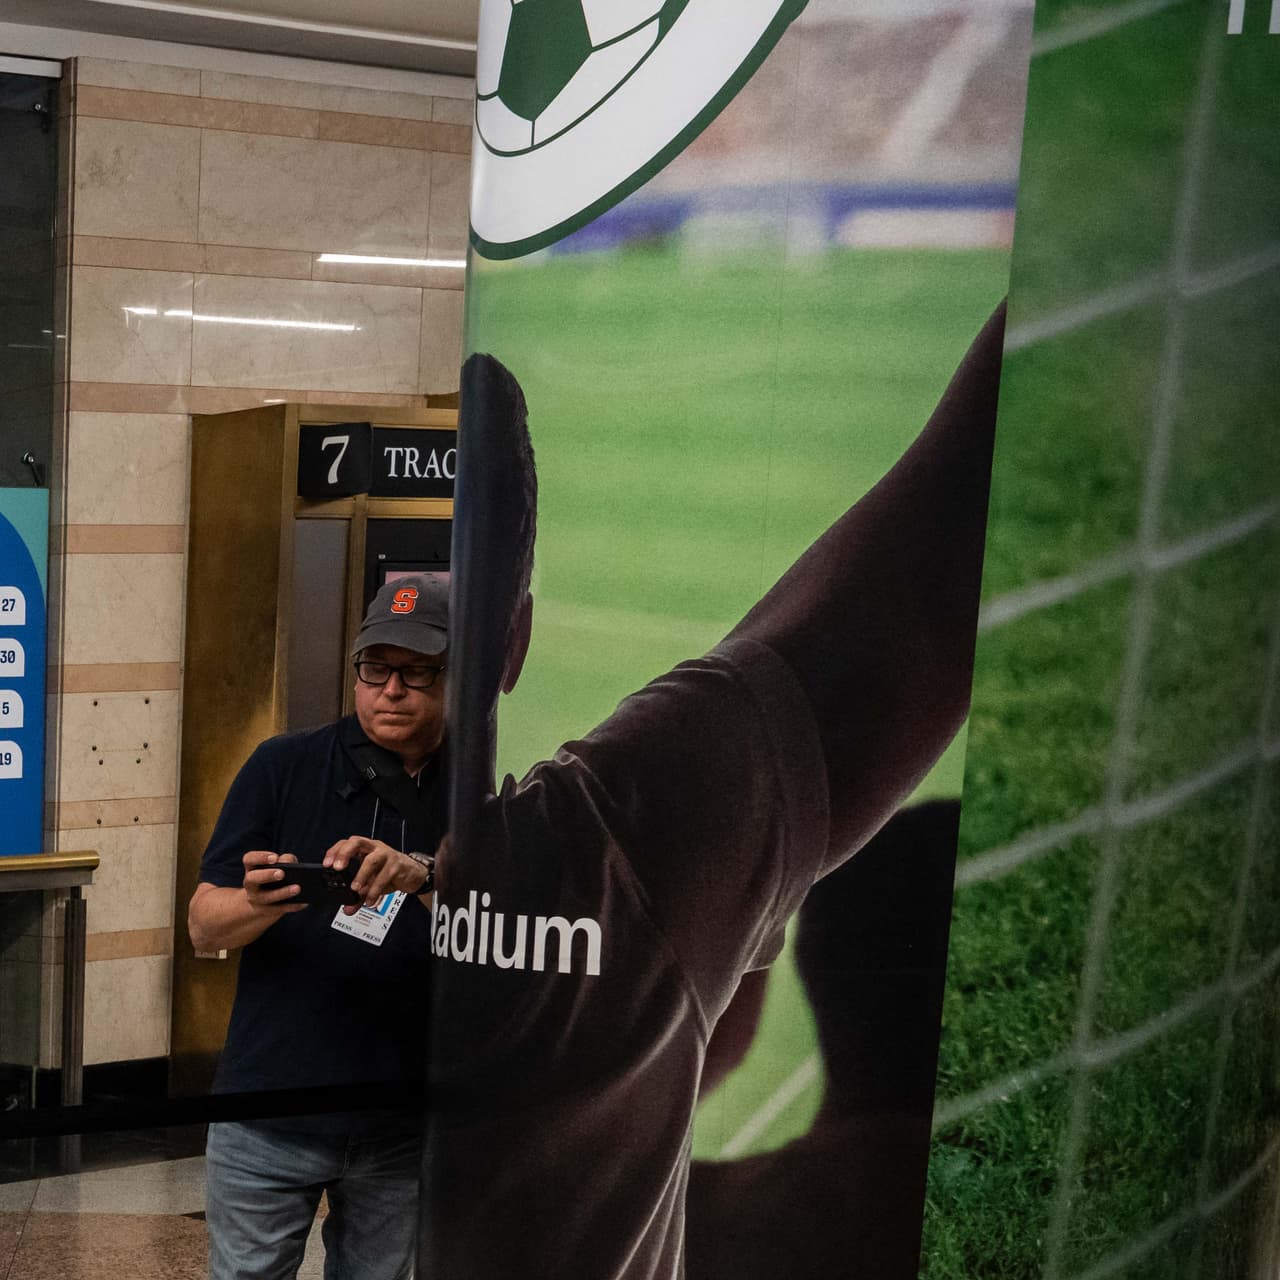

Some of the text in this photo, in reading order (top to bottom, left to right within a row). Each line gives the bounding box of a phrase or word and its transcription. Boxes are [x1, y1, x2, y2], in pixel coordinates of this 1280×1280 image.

[321, 434, 350, 484] 7
[1, 598, 16, 612] 27
[390, 587, 418, 615] S
[0, 650, 16, 664] 30
[1, 702, 10, 715] 5
